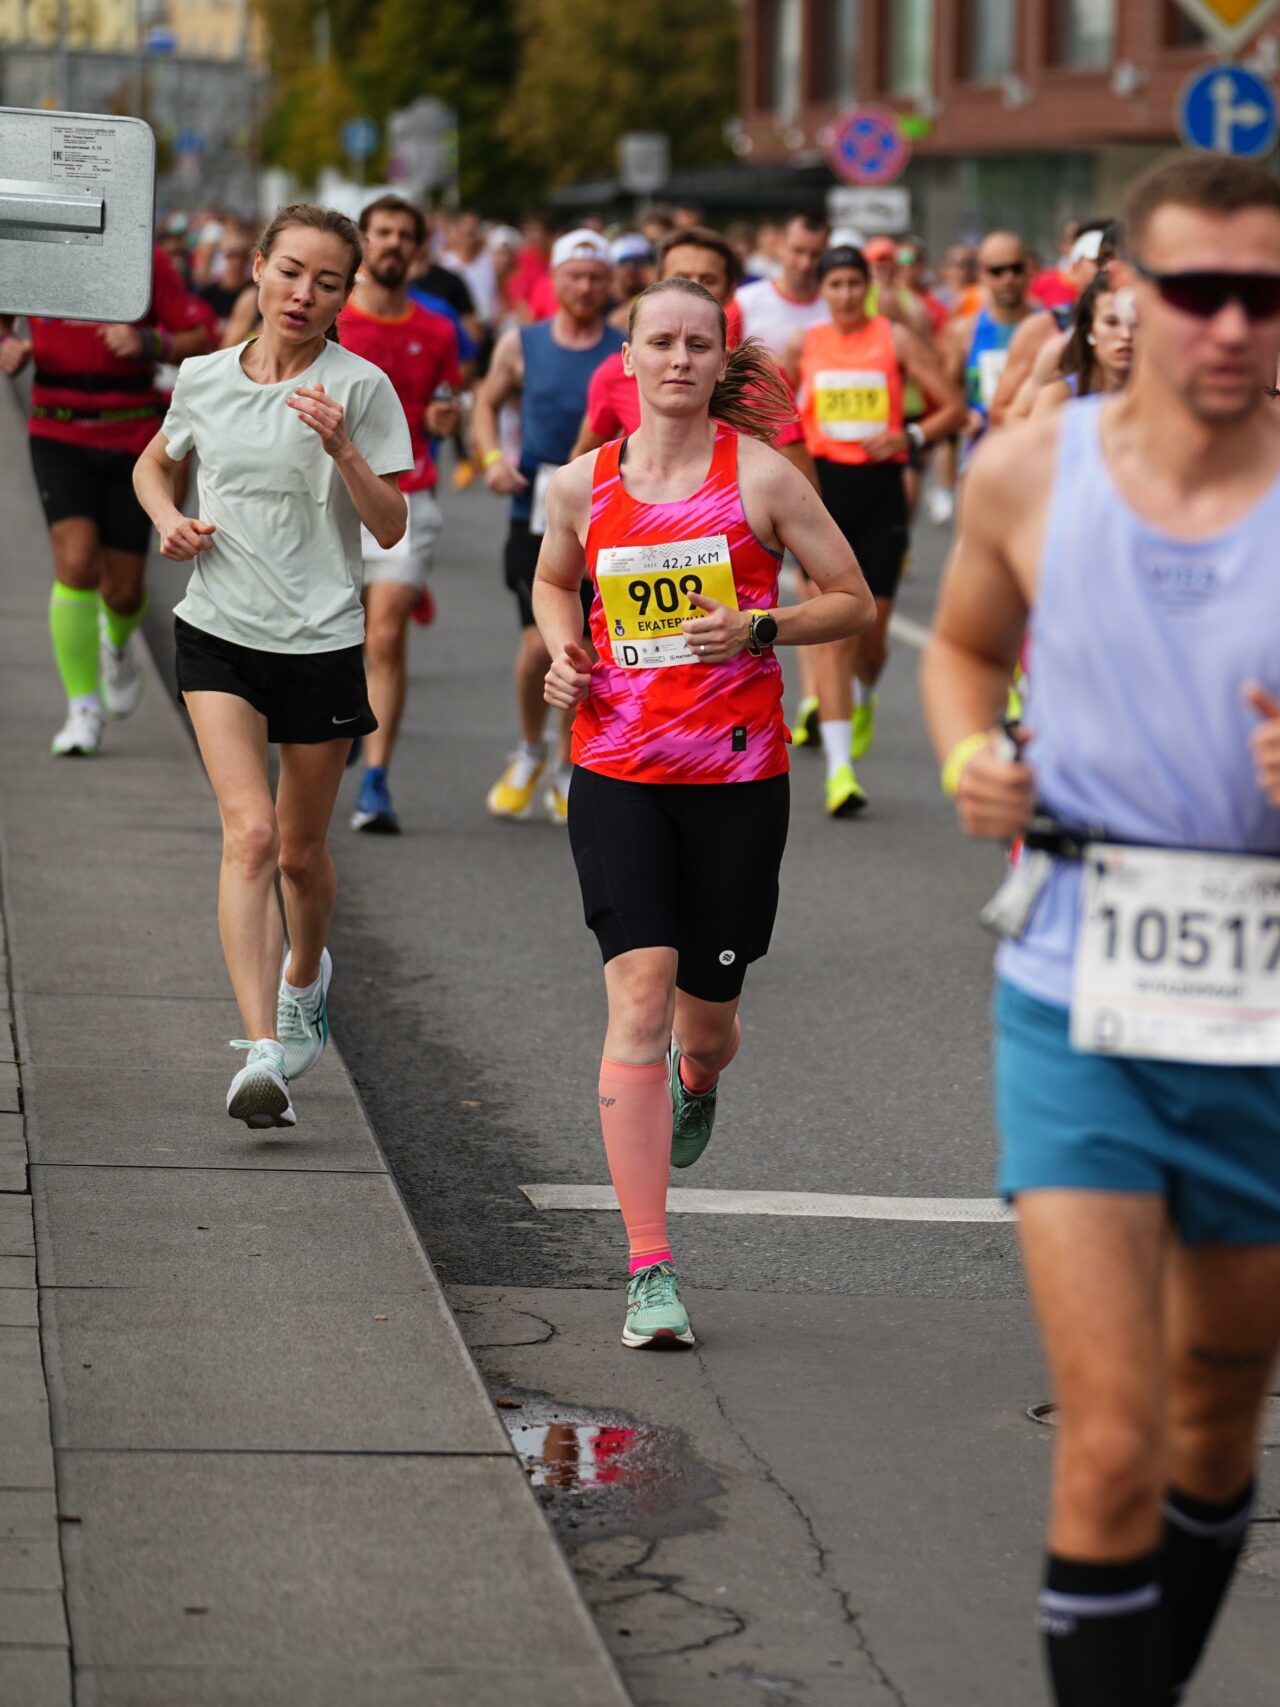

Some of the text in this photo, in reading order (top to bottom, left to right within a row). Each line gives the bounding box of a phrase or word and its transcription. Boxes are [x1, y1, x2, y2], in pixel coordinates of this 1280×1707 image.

[662, 556, 692, 570] 42,2
[628, 574, 703, 616] 909
[638, 614, 705, 632] ЕКАТЕР
[623, 645, 638, 666] D
